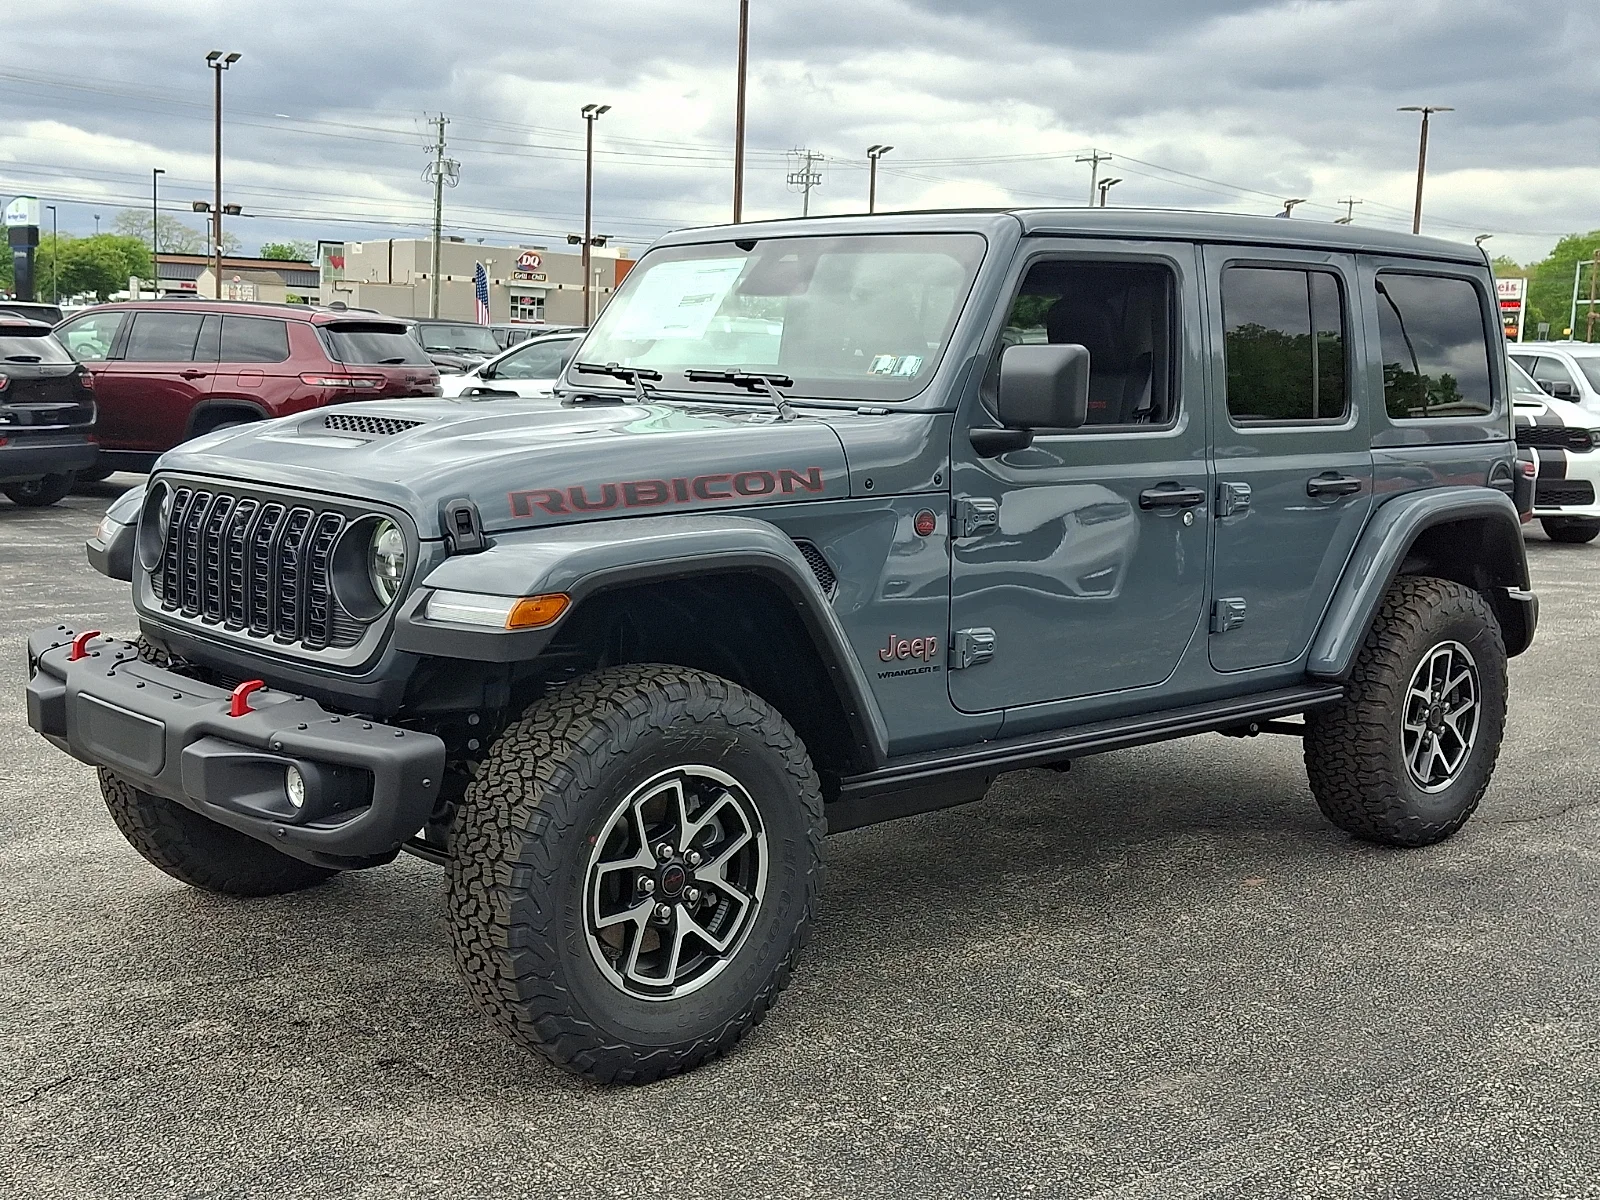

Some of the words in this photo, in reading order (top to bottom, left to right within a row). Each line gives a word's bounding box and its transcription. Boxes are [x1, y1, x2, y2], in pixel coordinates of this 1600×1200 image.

[521, 255, 540, 268] DQ
[508, 467, 824, 518] RUBICON
[879, 633, 938, 663] Jeep
[877, 666, 932, 680] WRANGLER
